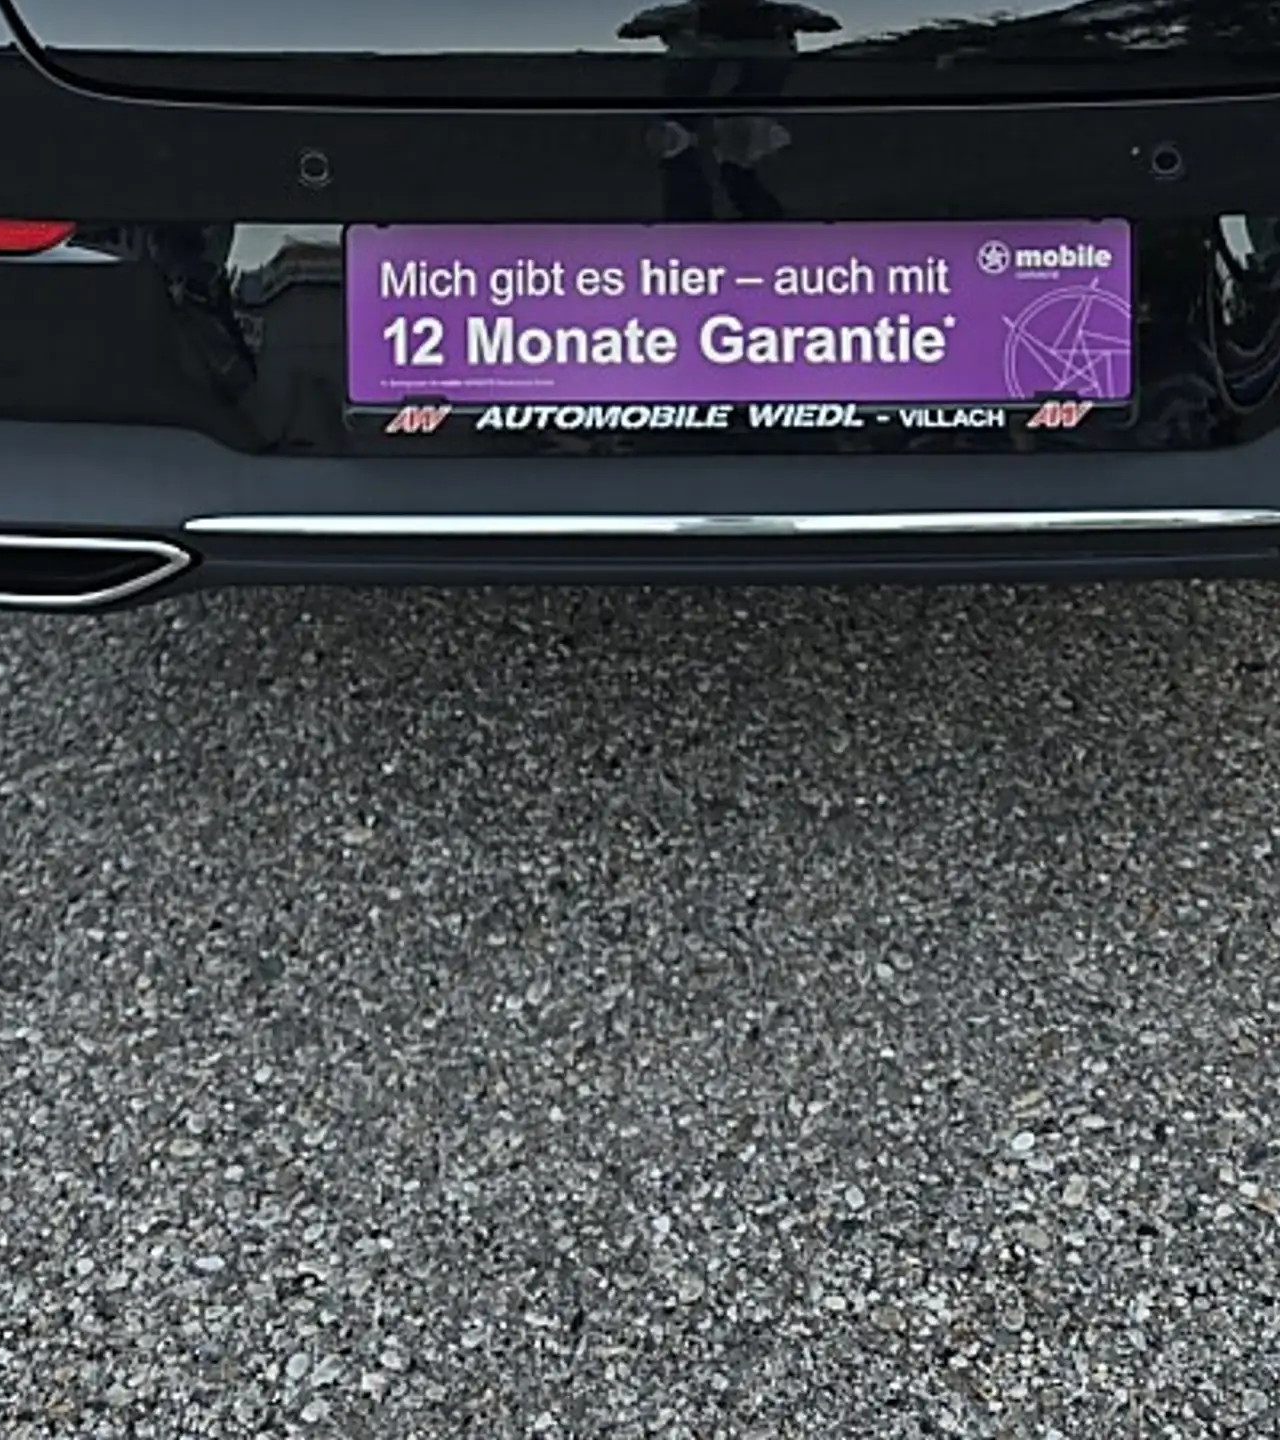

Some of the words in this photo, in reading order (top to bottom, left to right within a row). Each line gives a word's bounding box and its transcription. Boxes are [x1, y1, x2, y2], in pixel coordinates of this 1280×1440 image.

[1014, 243, 1113, 268] mobile
[381, 260, 477, 298] Mich
[490, 260, 565, 306] gibt
[576, 267, 625, 296] es
[641, 258, 726, 296] hier
[774, 257, 874, 295] auch
[888, 256, 952, 295] mit
[383, 316, 444, 366] 12
[467, 316, 677, 365] Monate
[475, 404, 734, 430] AUTOMOBILE
[748, 404, 864, 428] WIEDL
[899, 408, 1006, 428] VILLACH
